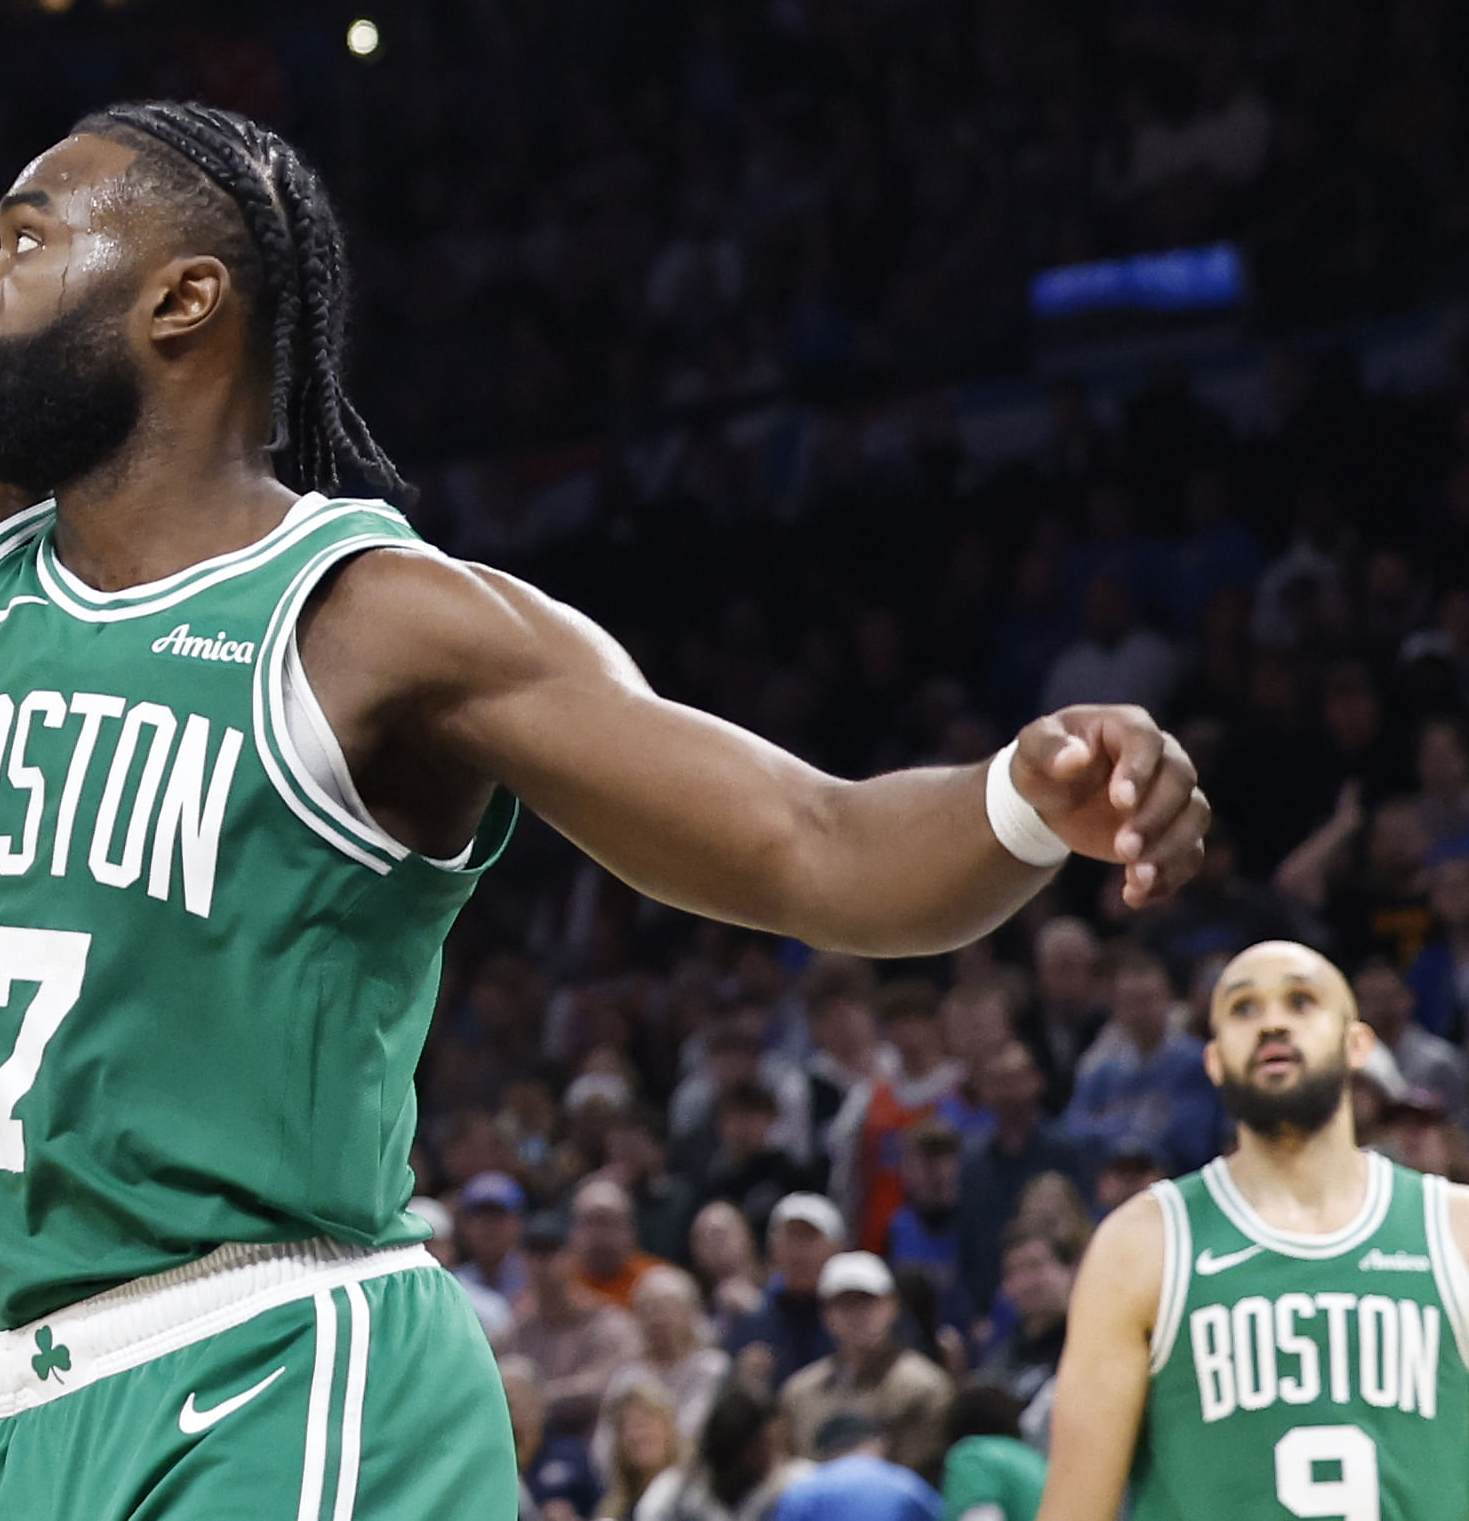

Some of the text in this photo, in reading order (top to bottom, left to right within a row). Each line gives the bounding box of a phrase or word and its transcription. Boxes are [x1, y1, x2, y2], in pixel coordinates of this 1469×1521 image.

[152, 623, 255, 664] Amica
[1189, 1291, 1441, 1423] BOSTON
[1274, 1425, 1381, 1521] 9
